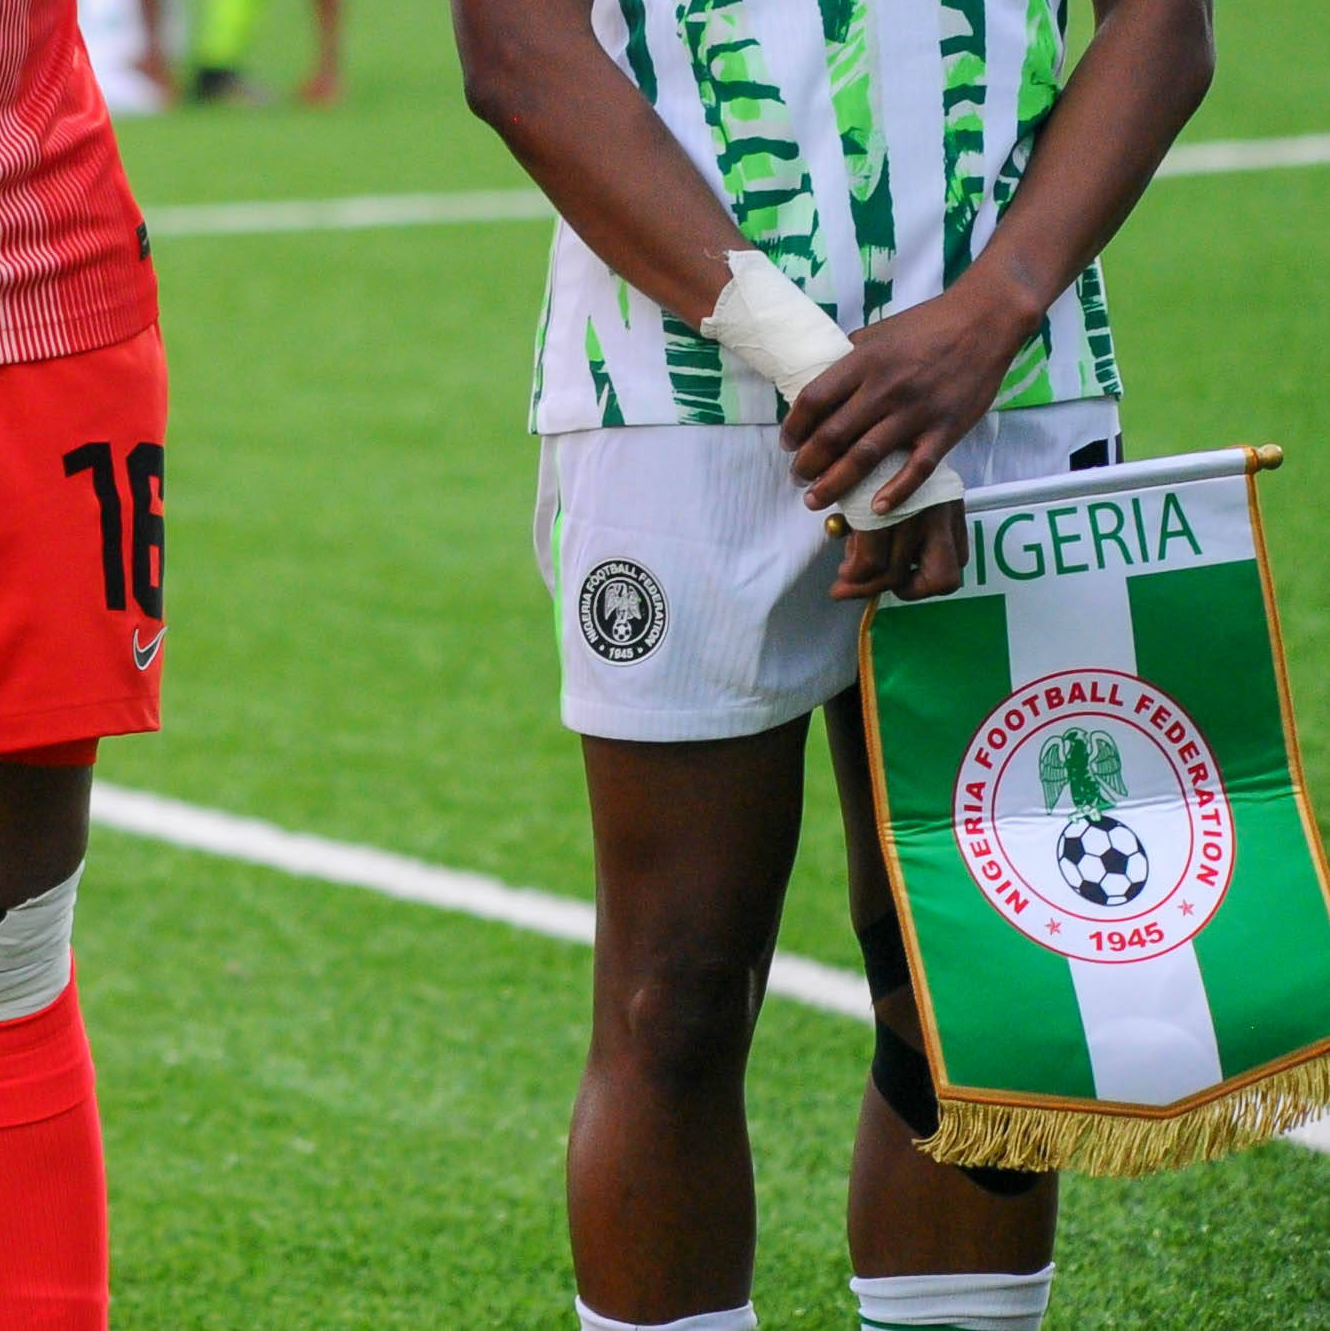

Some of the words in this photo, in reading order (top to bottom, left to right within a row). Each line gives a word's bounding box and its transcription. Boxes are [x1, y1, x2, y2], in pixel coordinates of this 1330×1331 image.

[63, 442, 165, 622] 16
[959, 493, 1202, 588] IGERIA
[581, 593, 599, 643] NIGERIA
[586, 563, 638, 592] FOOTBALL
[638, 572, 664, 647] FEDERATION
[609, 648, 634, 659] 1945
[974, 681, 1123, 770] FOOTBALL
[1134, 694, 1223, 887] FEDERATION
[964, 781, 1029, 915] NIGERIA
[1089, 922, 1164, 952] 1945
